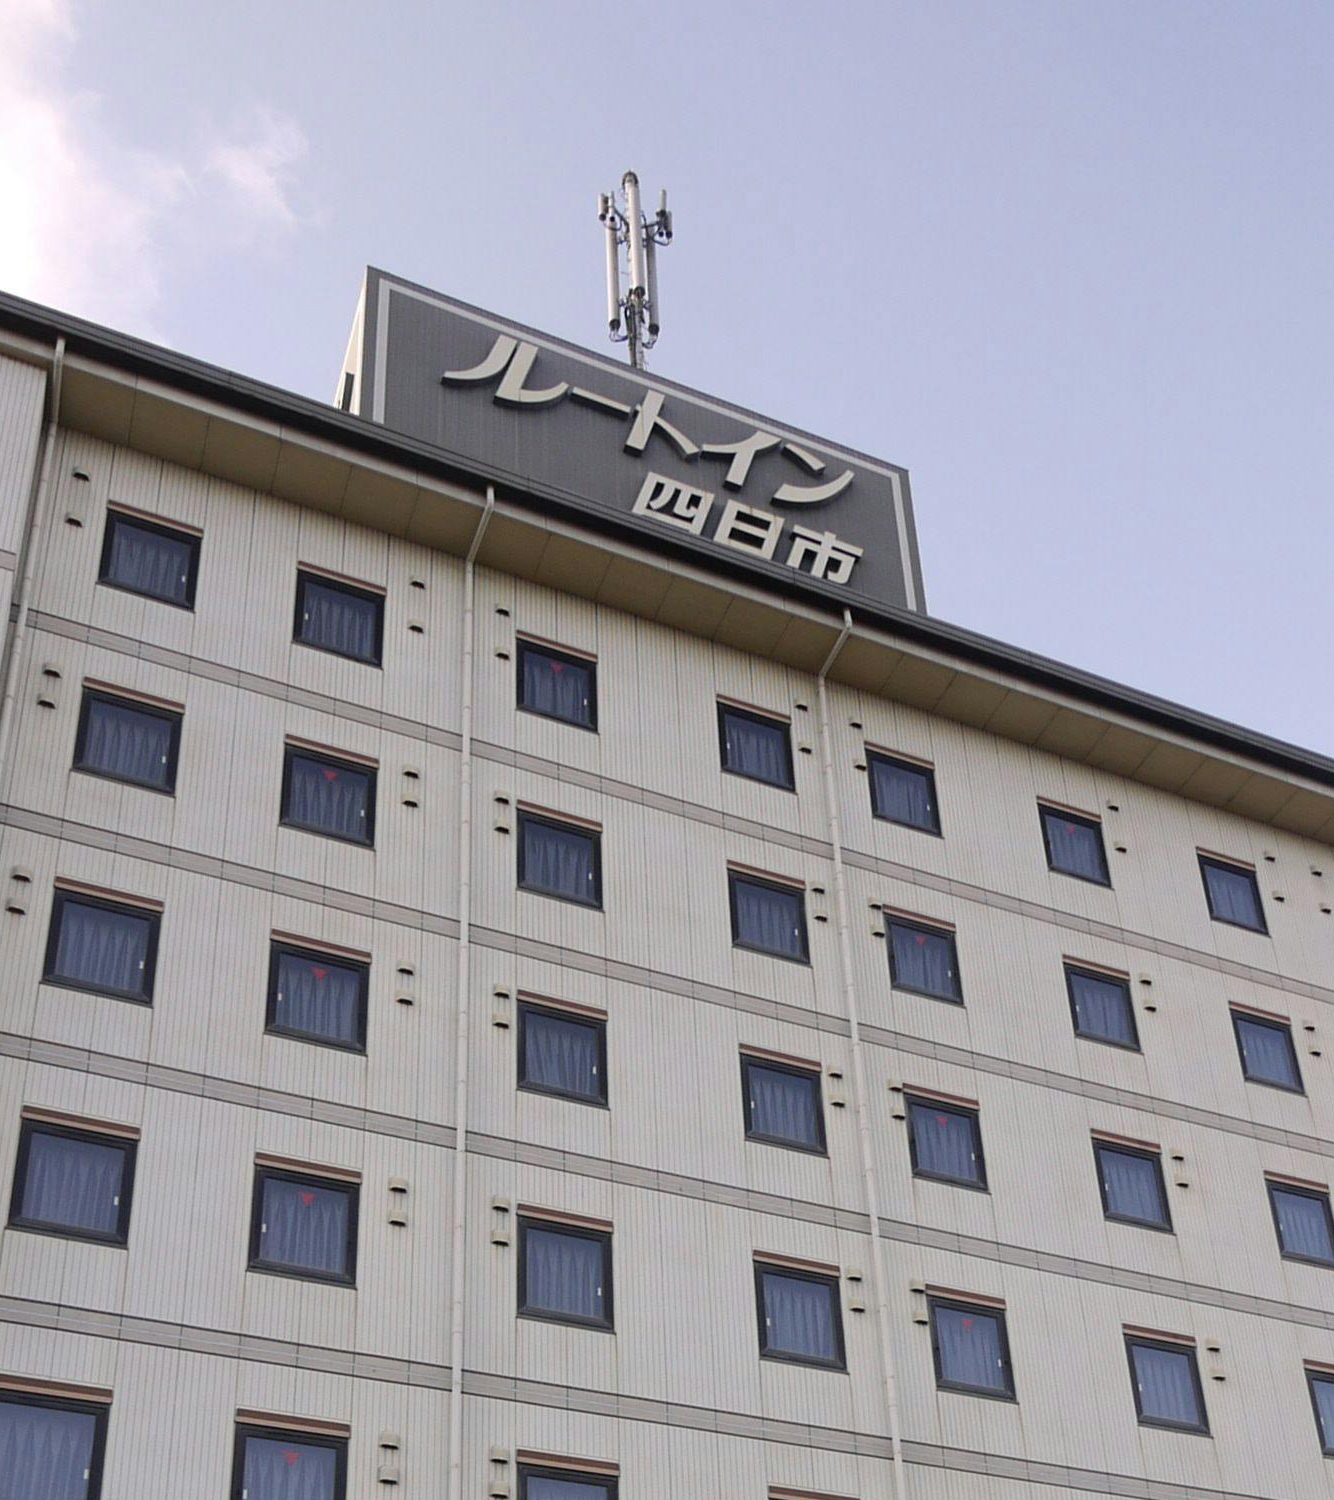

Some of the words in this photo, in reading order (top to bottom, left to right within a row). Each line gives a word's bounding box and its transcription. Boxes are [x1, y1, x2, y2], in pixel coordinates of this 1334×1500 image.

[441, 334, 855, 508] ルートイン
[632, 471, 865, 585] 四日市
